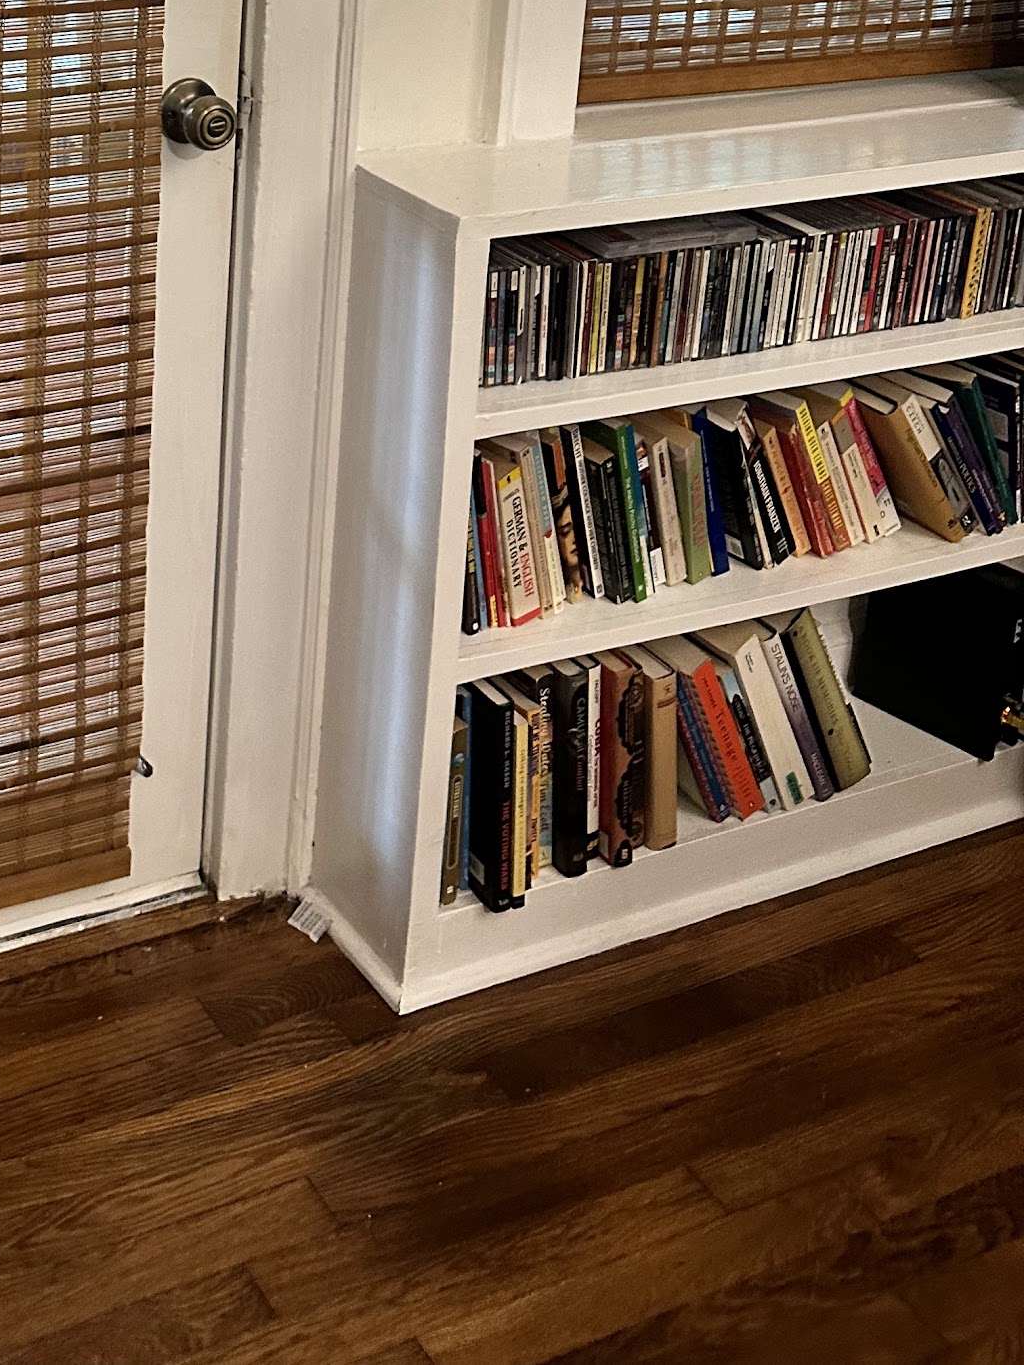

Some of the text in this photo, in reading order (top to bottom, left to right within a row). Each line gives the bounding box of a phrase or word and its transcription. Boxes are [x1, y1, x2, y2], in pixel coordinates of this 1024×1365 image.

[906, 405, 923, 434] CZECH
[572, 425, 582, 458] BRECHT
[578, 459, 587, 484] MOTHER
[959, 462, 977, 494] POETICS
[581, 484, 592, 513] COURAGE
[753, 459, 781, 533] JONATHAN FRANZEN
[586, 514, 594, 527] AND
[506, 519, 522, 588] DICTIONARY
[512, 496, 535, 597] GERMAN & ENGLISH
[590, 540, 599, 569] CHILDREN
[539, 687, 552, 735] Stealing
[785, 683, 801, 713] NOSE
[576, 697, 586, 739] CAMUS
[716, 708, 738, 761] Teenage
[541, 740, 552, 775] Water
[576, 753, 586, 791] Combat
[500, 799, 511, 890] THE VOTING WARS
